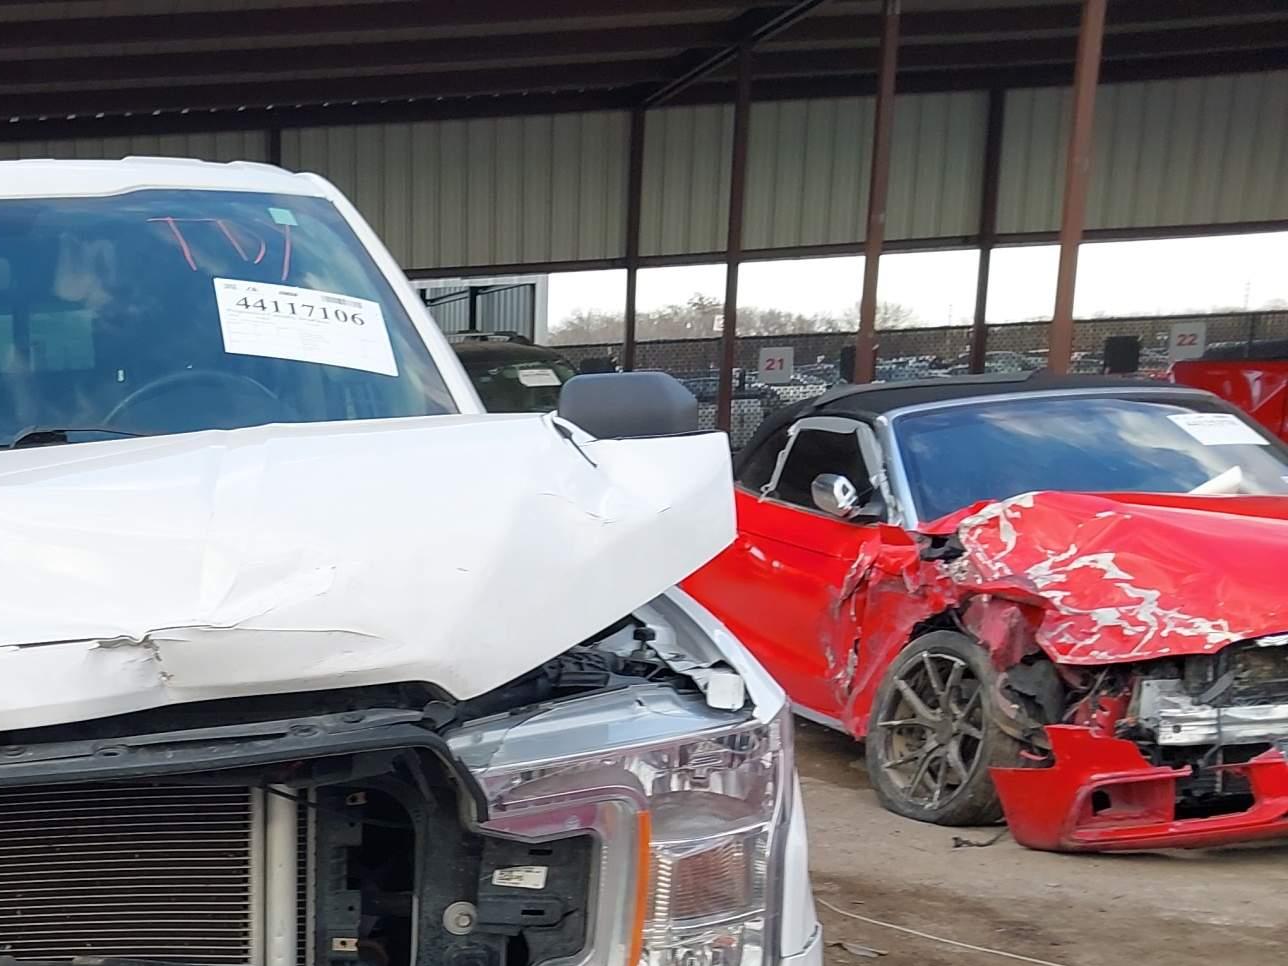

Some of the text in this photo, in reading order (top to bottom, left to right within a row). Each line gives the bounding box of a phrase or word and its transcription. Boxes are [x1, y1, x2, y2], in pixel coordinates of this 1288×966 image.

[235, 296, 365, 326] 44117106
[1176, 333, 1198, 346] 22
[765, 358, 784, 370] 21
